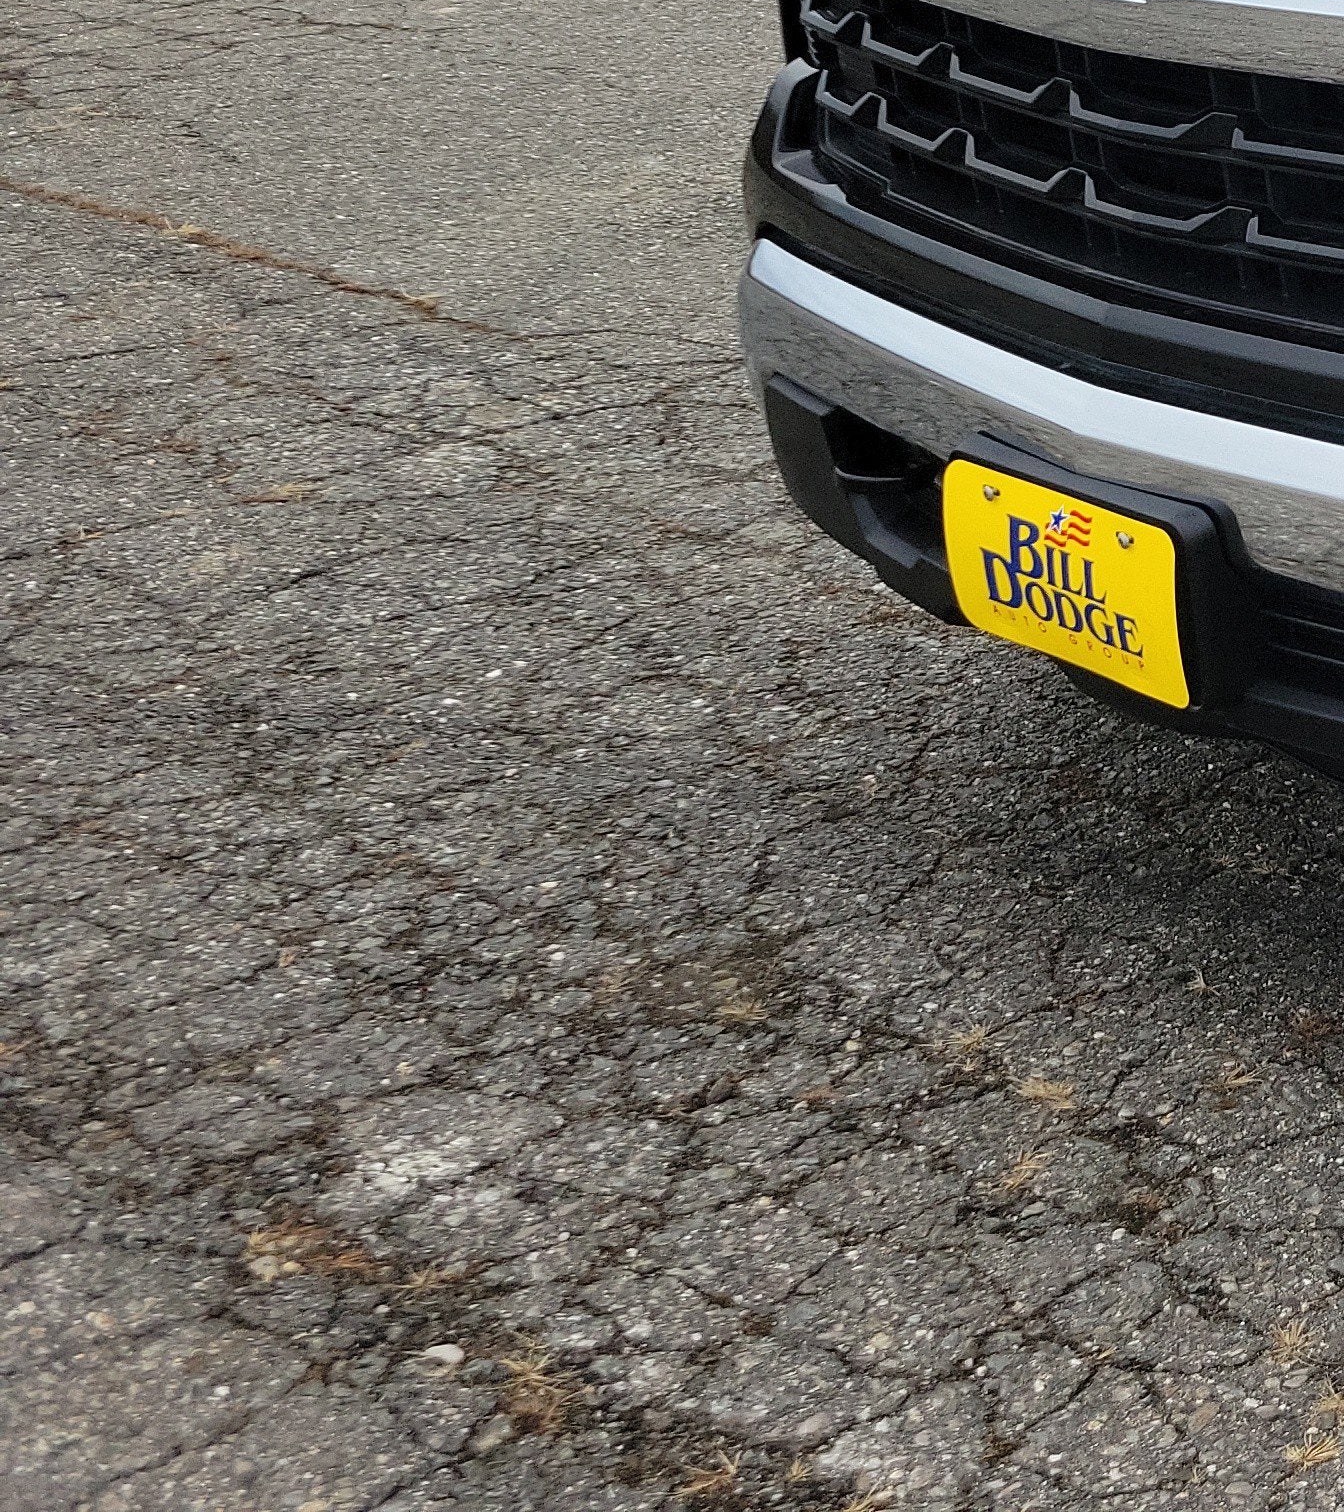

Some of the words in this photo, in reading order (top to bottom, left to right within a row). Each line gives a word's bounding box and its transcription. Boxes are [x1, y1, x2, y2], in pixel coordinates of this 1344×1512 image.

[980, 547, 1144, 658] DODGE
[1007, 514, 1107, 605] BILL
[993, 604, 1047, 633] AUTO
[1069, 633, 1145, 669] GROUP
